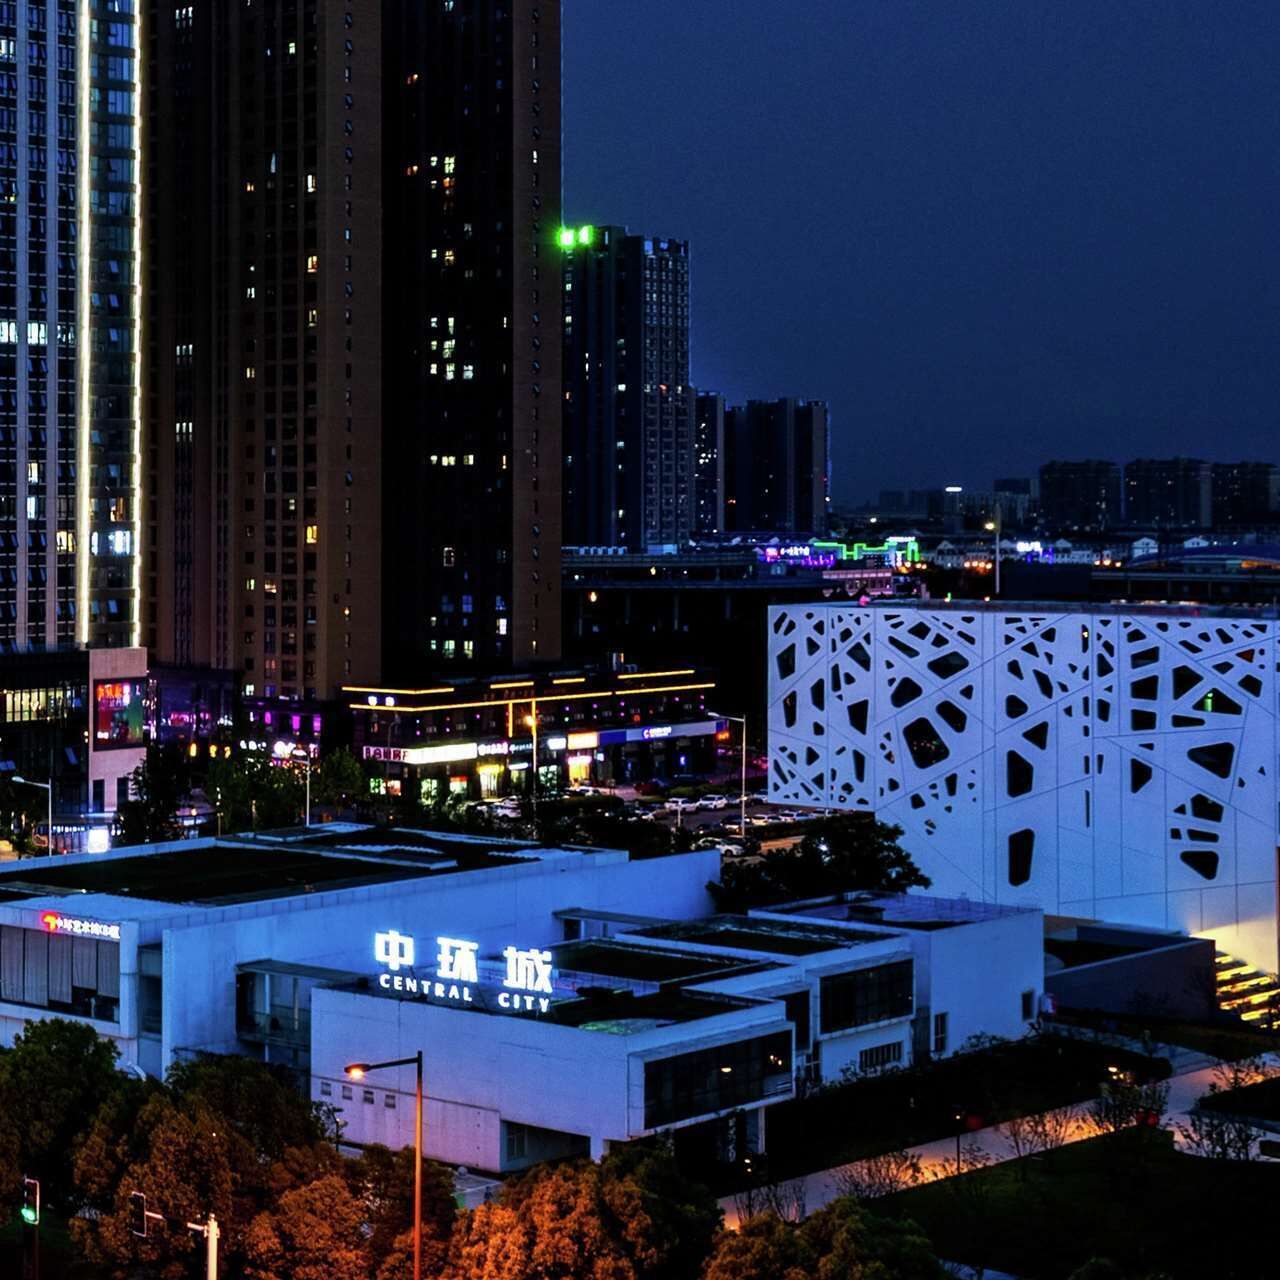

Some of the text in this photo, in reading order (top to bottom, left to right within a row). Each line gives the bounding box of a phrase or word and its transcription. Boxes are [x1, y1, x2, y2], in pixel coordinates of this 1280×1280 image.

[375, 929, 552, 994] 中环城
[379, 973, 550, 1013] CENTRAL CITY
